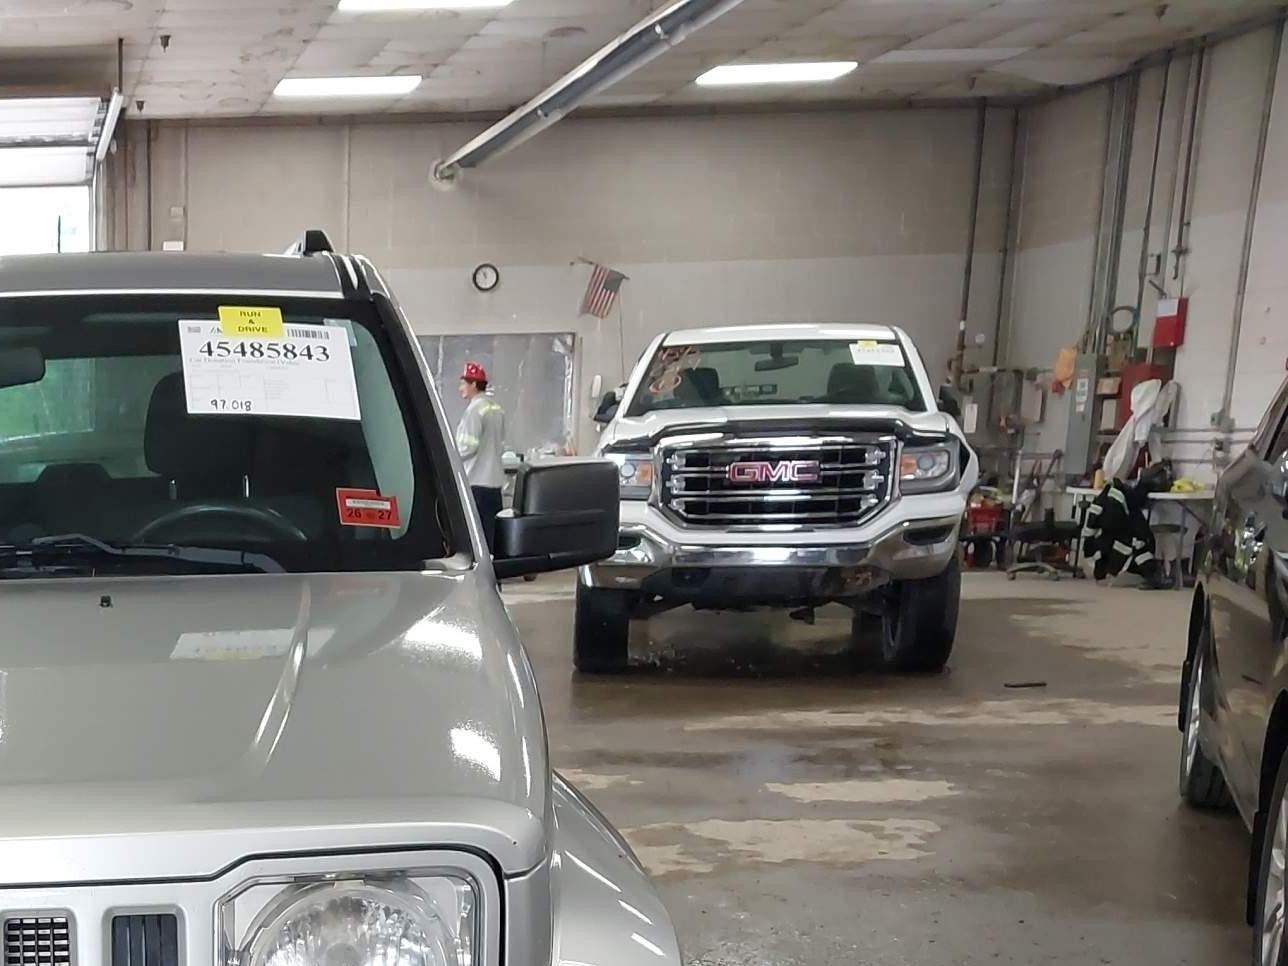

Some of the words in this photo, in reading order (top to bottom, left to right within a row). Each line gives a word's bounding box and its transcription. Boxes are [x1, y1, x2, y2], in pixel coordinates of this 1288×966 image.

[239, 310, 262, 318] RUN
[237, 326, 268, 334] DRIVE
[199, 341, 330, 362] 45485843
[728, 461, 820, 482] GMC
[347, 509, 362, 518] 26
[377, 510, 392, 520] 27
